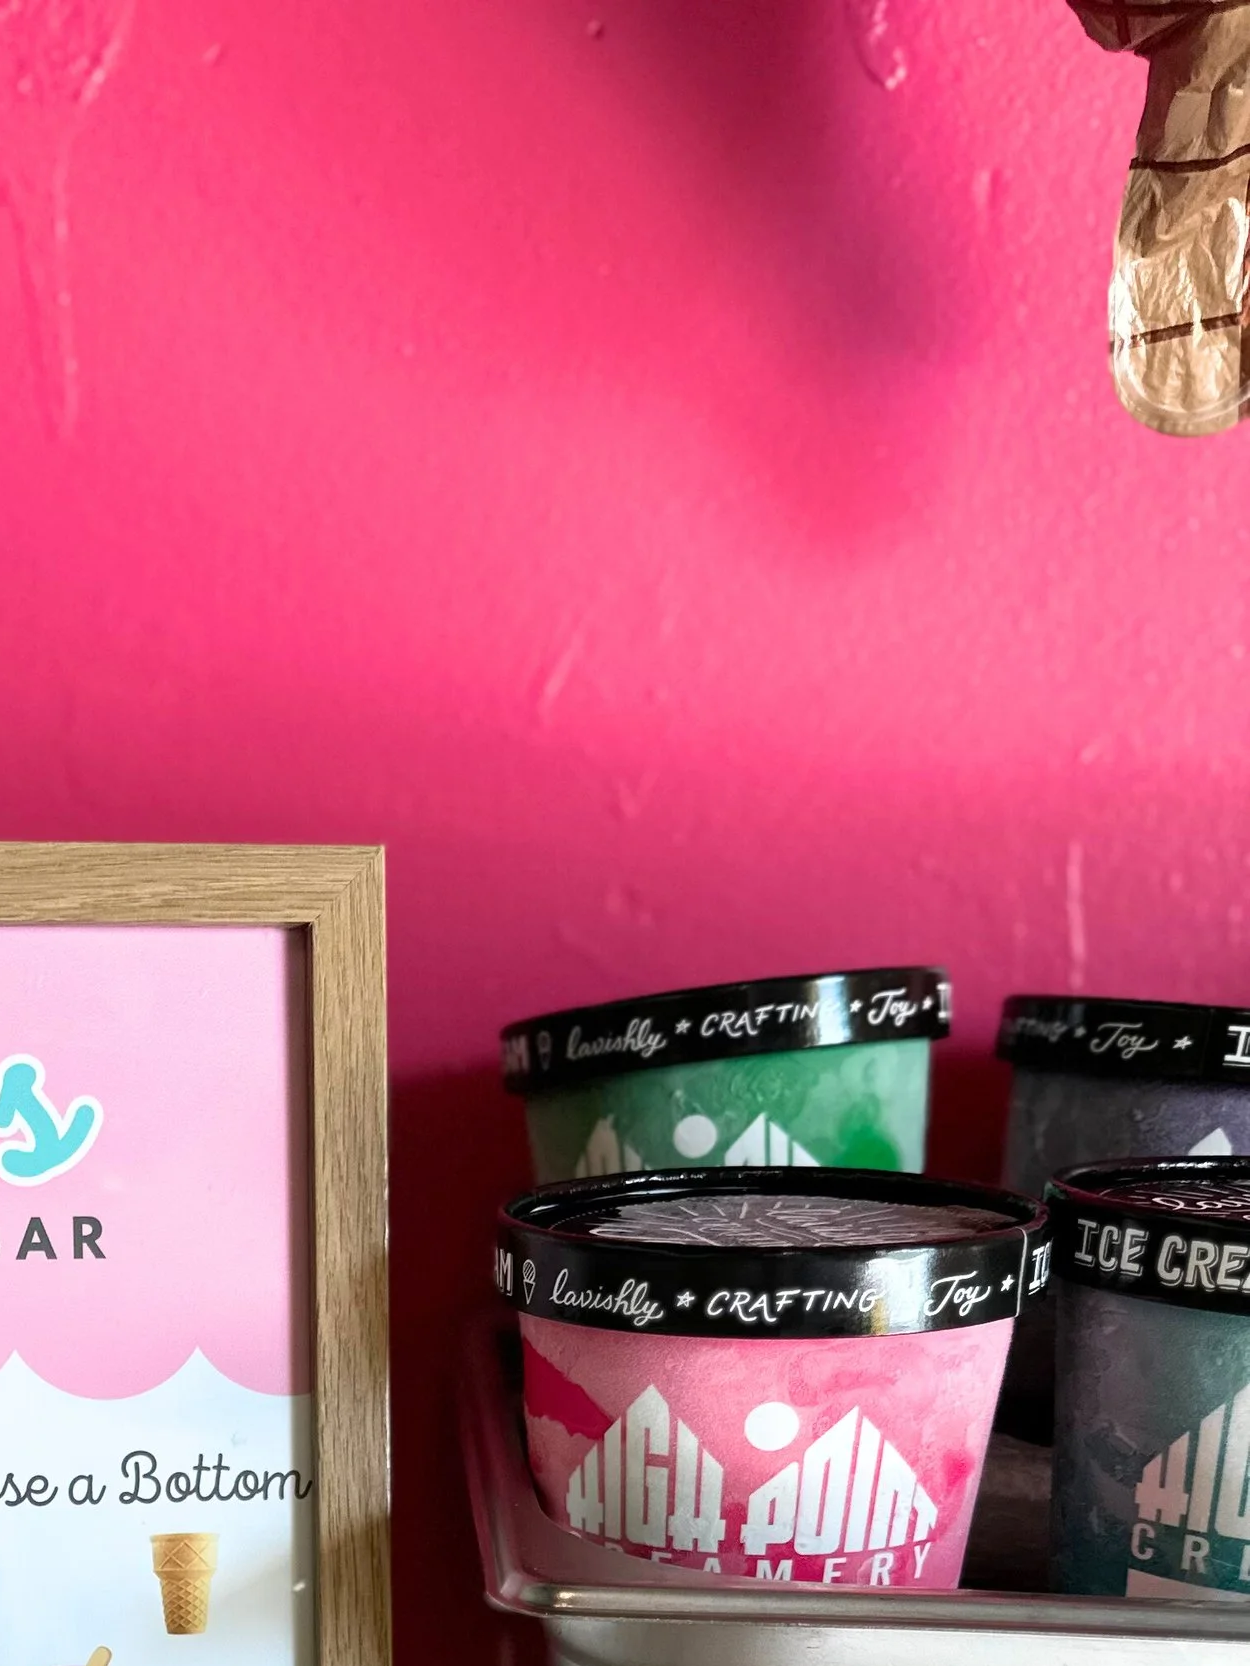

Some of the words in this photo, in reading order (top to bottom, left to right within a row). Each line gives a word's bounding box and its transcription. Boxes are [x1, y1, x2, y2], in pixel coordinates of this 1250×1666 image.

[565, 1017, 669, 1058] lavishly
[699, 999, 840, 1038] CRAFTIN
[867, 986, 918, 1027] Joy
[1074, 1218, 1150, 1278] ICE
[1156, 1234, 1250, 1295] CRE
[548, 1268, 665, 1326] lavishly
[706, 1288, 886, 1323] CRAFTING
[922, 1271, 991, 1317] Joy
[67, 1473, 107, 1506] a
[119, 1450, 314, 1504] Bottom
[565, 1384, 726, 1553] HIGH
[740, 1405, 939, 1556] POINT
